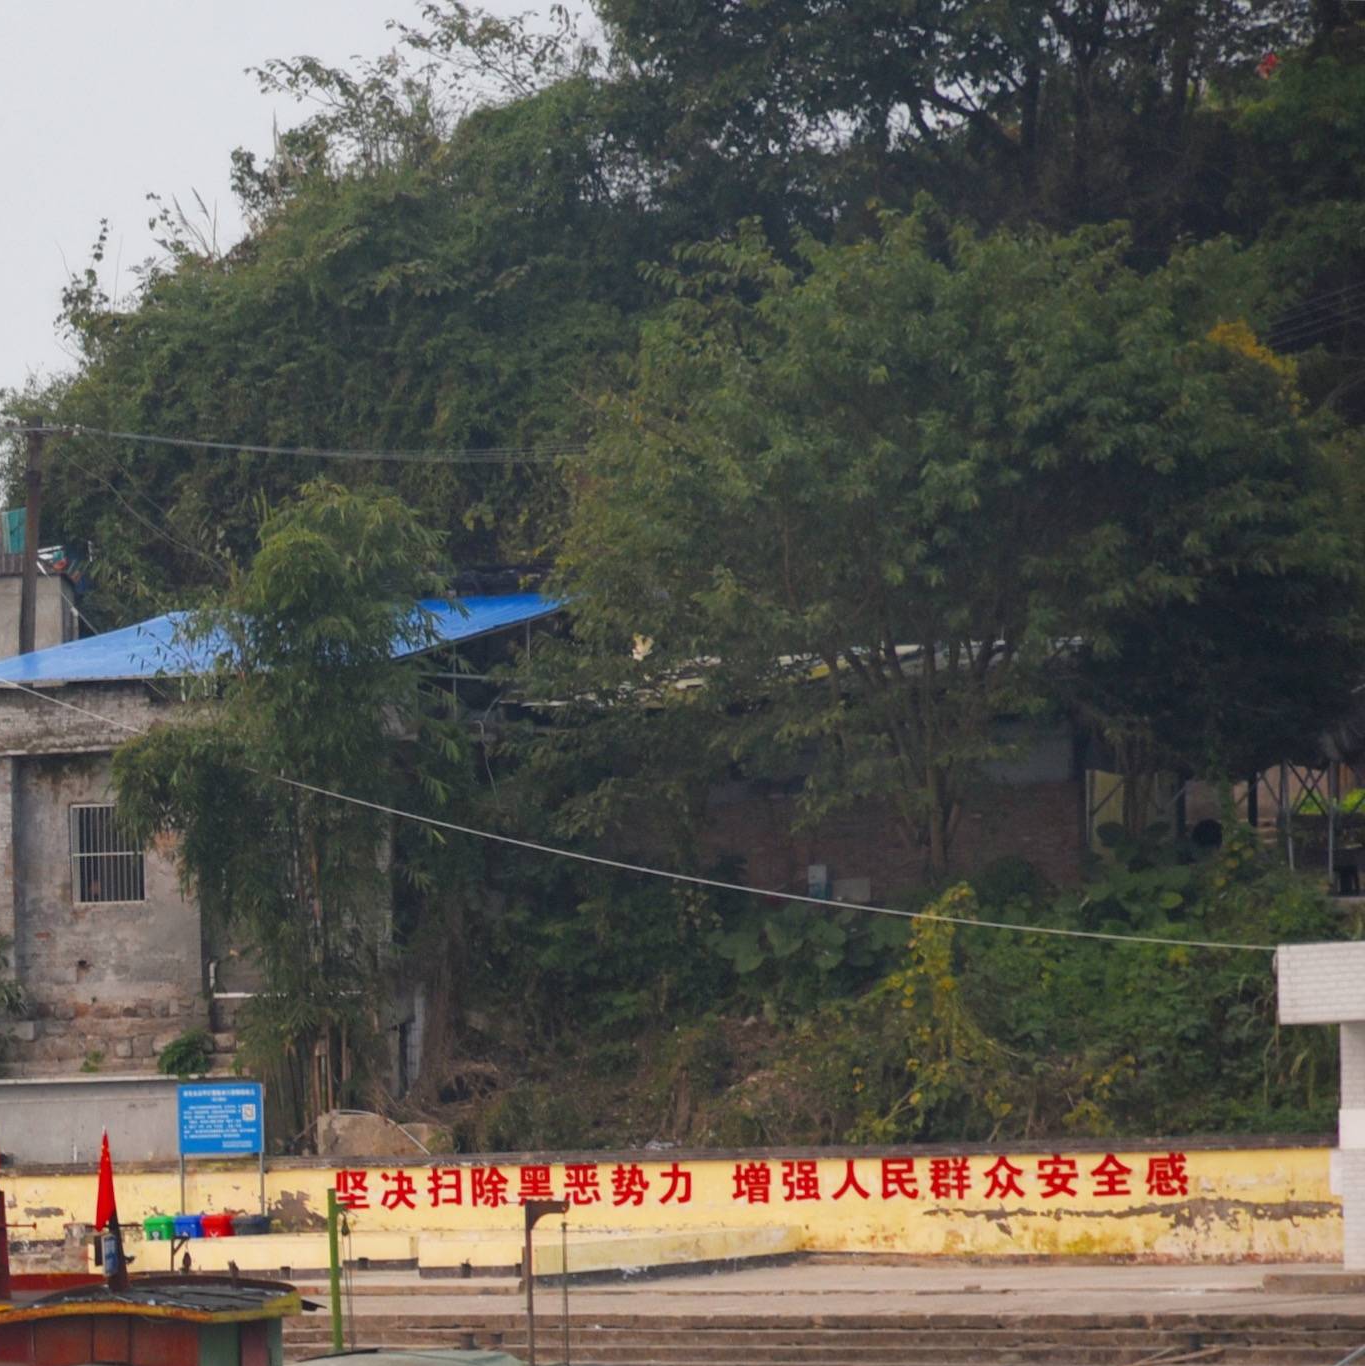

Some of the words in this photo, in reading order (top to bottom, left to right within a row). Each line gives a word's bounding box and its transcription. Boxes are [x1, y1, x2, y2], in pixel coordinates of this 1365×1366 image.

[335, 1162, 693, 1210] 坚决扫除黑恶势力
[732, 1152, 1189, 1204] 增强人民群众安全感
